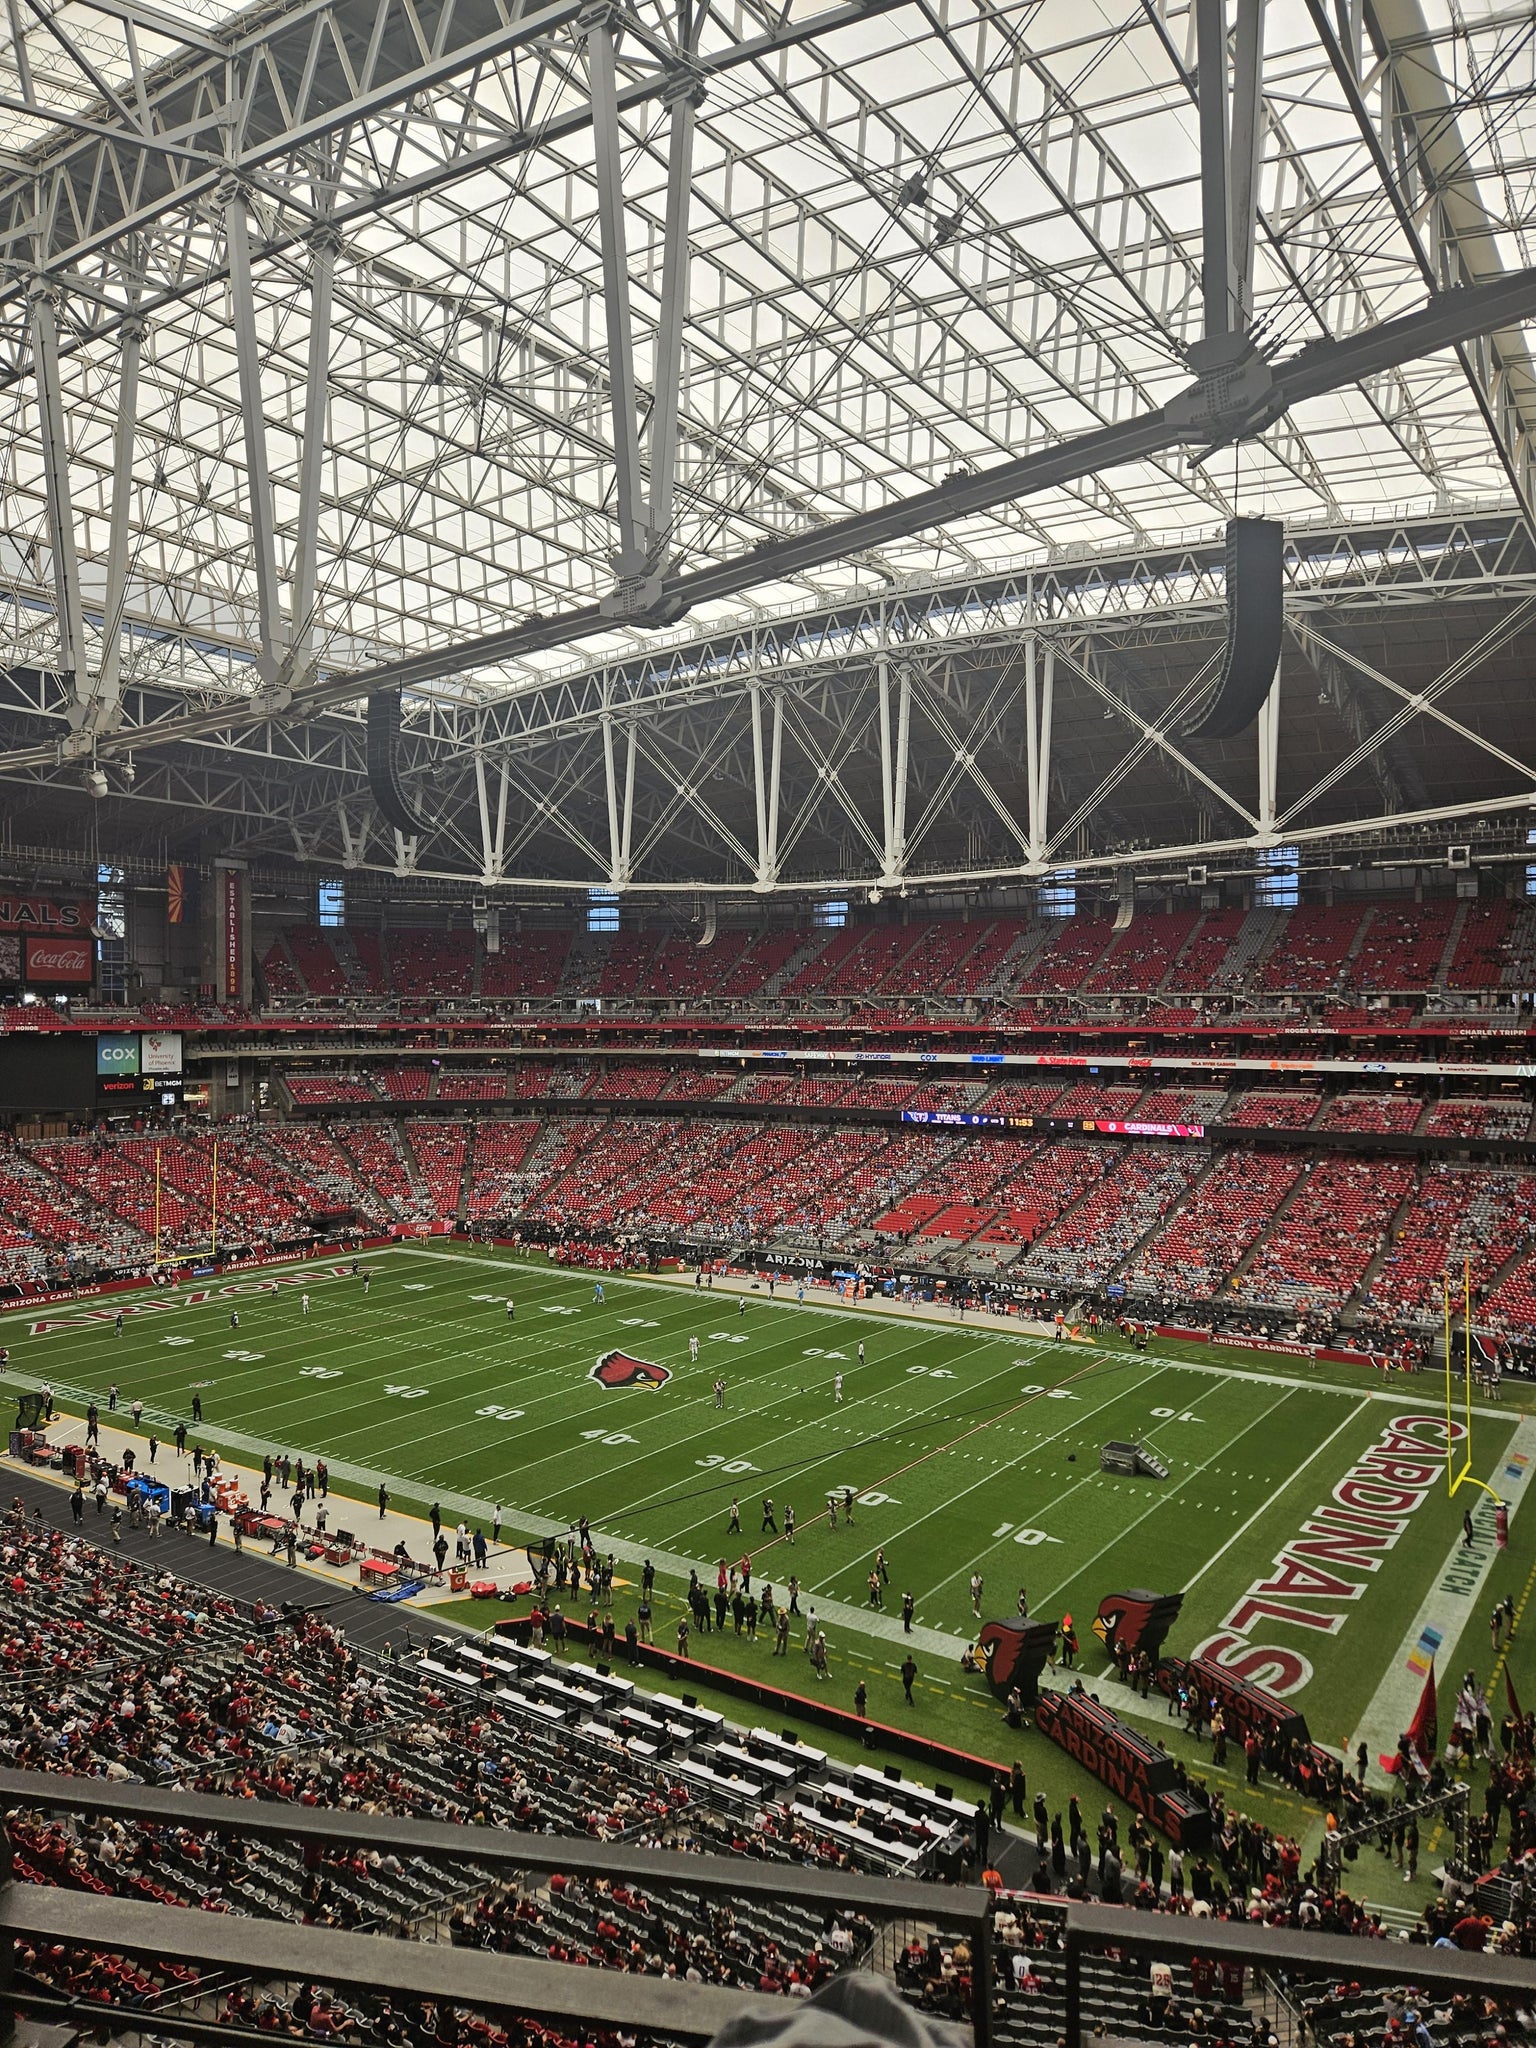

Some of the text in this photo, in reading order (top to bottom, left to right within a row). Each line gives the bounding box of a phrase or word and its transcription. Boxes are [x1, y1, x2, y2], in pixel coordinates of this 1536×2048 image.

[102, 1048, 135, 1060] COX
[148, 1053, 174, 1061] University
[1049, 1056, 1087, 1066] State Farm
[103, 1081, 134, 1090] verizon
[155, 1080, 182, 1088] BETMGM
[935, 1113, 961, 1121] TITANS
[971, 1115, 980, 1124] 0
[1008, 1117, 1033, 1127] 11:53
[1109, 1122, 1117, 1131] 0
[1124, 1123, 1172, 1133] CARDINALS
[226, 1252, 302, 1270] ARIZONA CARDINALS
[3, 1286, 101, 1309] ARIZONA CARDNALS
[25, 1265, 386, 1336] ARIZONA
[707, 1332, 750, 1343] 50
[1212, 1336, 1311, 1356] ARIZONA CARDINALS
[905, 1365, 954, 1379] 30
[385, 1384, 430, 1399] 40
[1020, 1385, 1072, 1400] 20
[474, 1404, 525, 1421] 50
[1150, 1407, 1194, 1422] 10
[579, 1428, 633, 1446] 40
[694, 1454, 753, 1474] 30
[824, 1485, 890, 1507] 20
[992, 1522, 1049, 1546] 10
[1190, 1414, 1469, 1699] CARDINALS
[455, 1575, 463, 1585] G
[1439, 1549, 1488, 1597] CATCH
[1060, 1702, 1150, 1786] ARIZONA
[1035, 1704, 1182, 1841] CARDINALS
